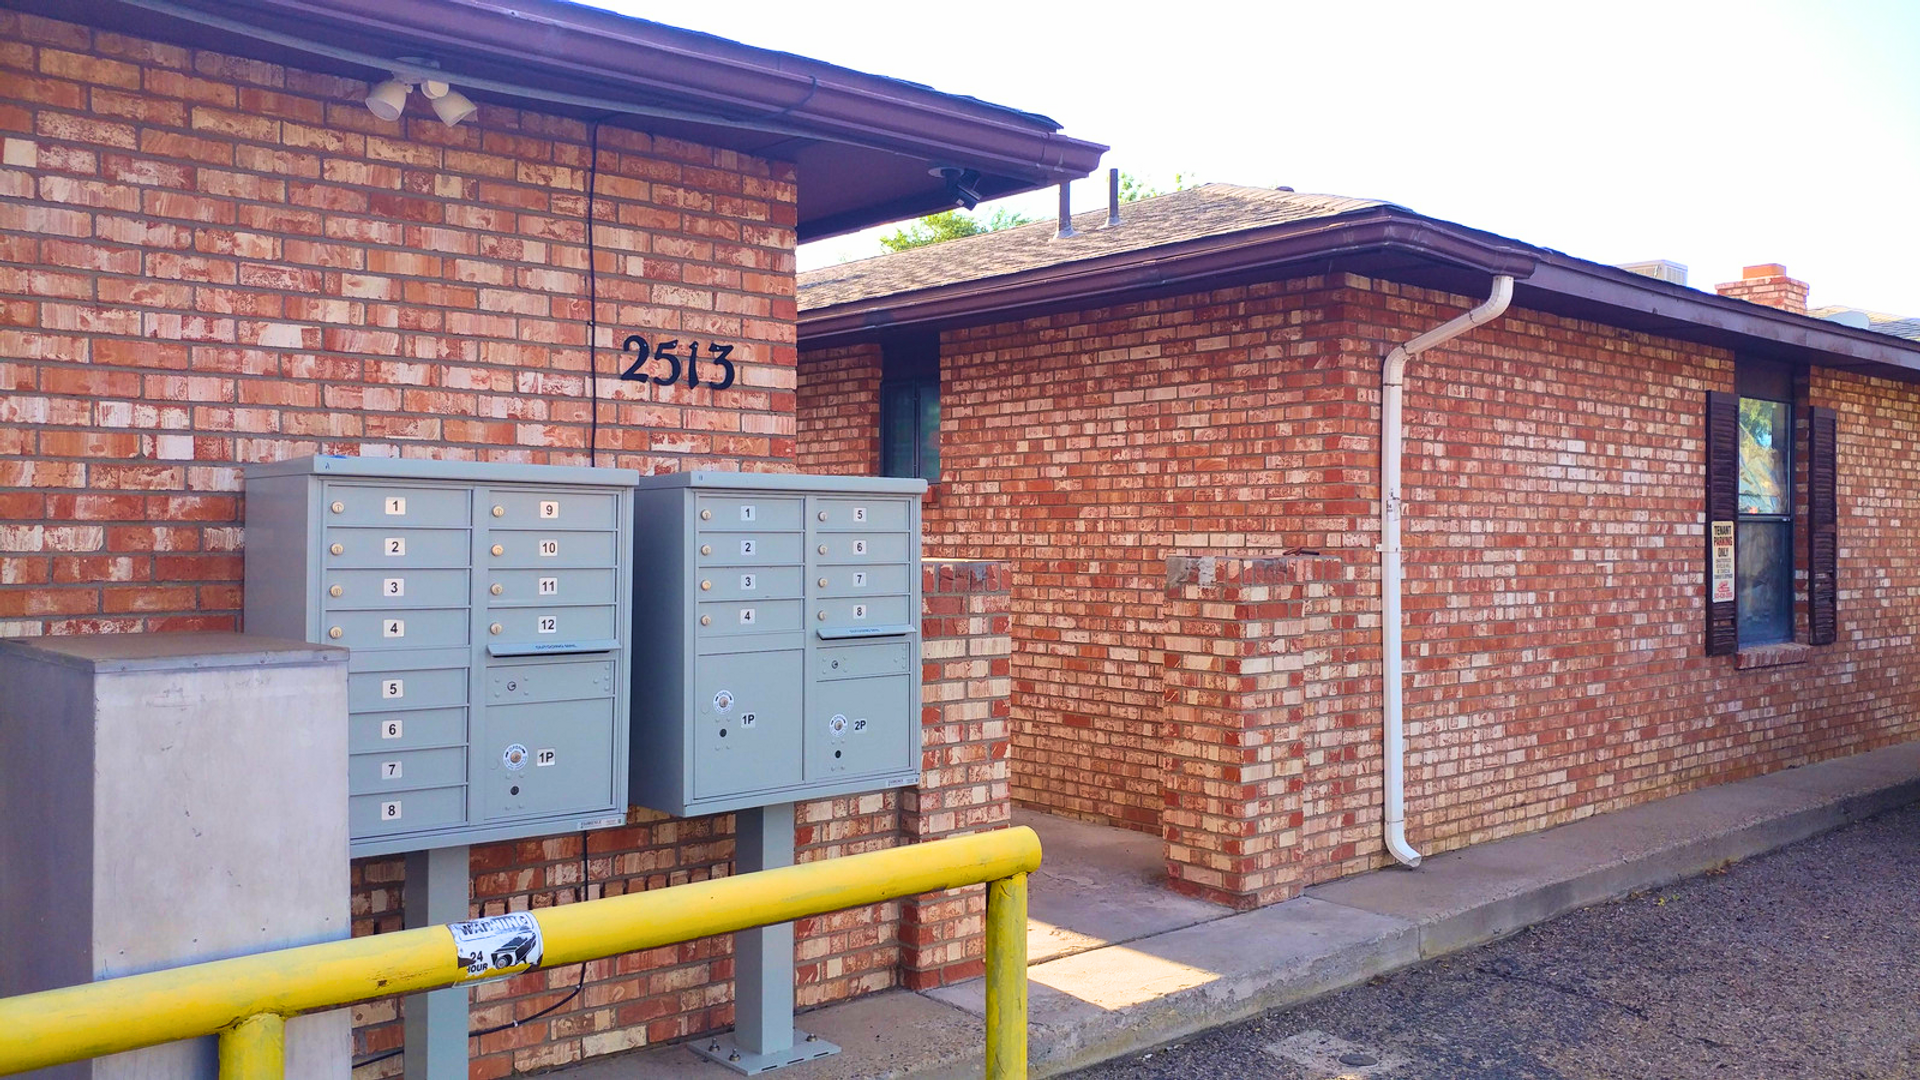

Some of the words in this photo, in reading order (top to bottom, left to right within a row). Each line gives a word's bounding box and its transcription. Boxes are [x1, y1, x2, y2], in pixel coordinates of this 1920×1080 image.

[620, 334, 735, 391] 2513
[392, 500, 398, 511] 1
[545, 504, 553, 515] 9
[745, 508, 750, 518] 1
[857, 509, 863, 519] 5
[391, 541, 399, 552] 2
[542, 542, 556, 553] 10
[745, 542, 751, 552] 2
[856, 542, 862, 552] 6
[745, 576, 751, 586] 3
[856, 574, 862, 584] 7
[390, 582, 398, 593] 3
[542, 581, 555, 592] 11
[744, 610, 751, 620] 4
[856, 606, 862, 616] 8
[390, 623, 398, 634] 4
[541, 619, 554, 630] 12
[389, 684, 397, 695] 5
[742, 714, 755, 725] 1P
[388, 724, 396, 735] 6
[854, 720, 867, 731] 2P
[538, 751, 554, 763] 1P
[388, 764, 396, 775] 7
[387, 804, 396, 816] 8
[470, 951, 483, 963] 24
